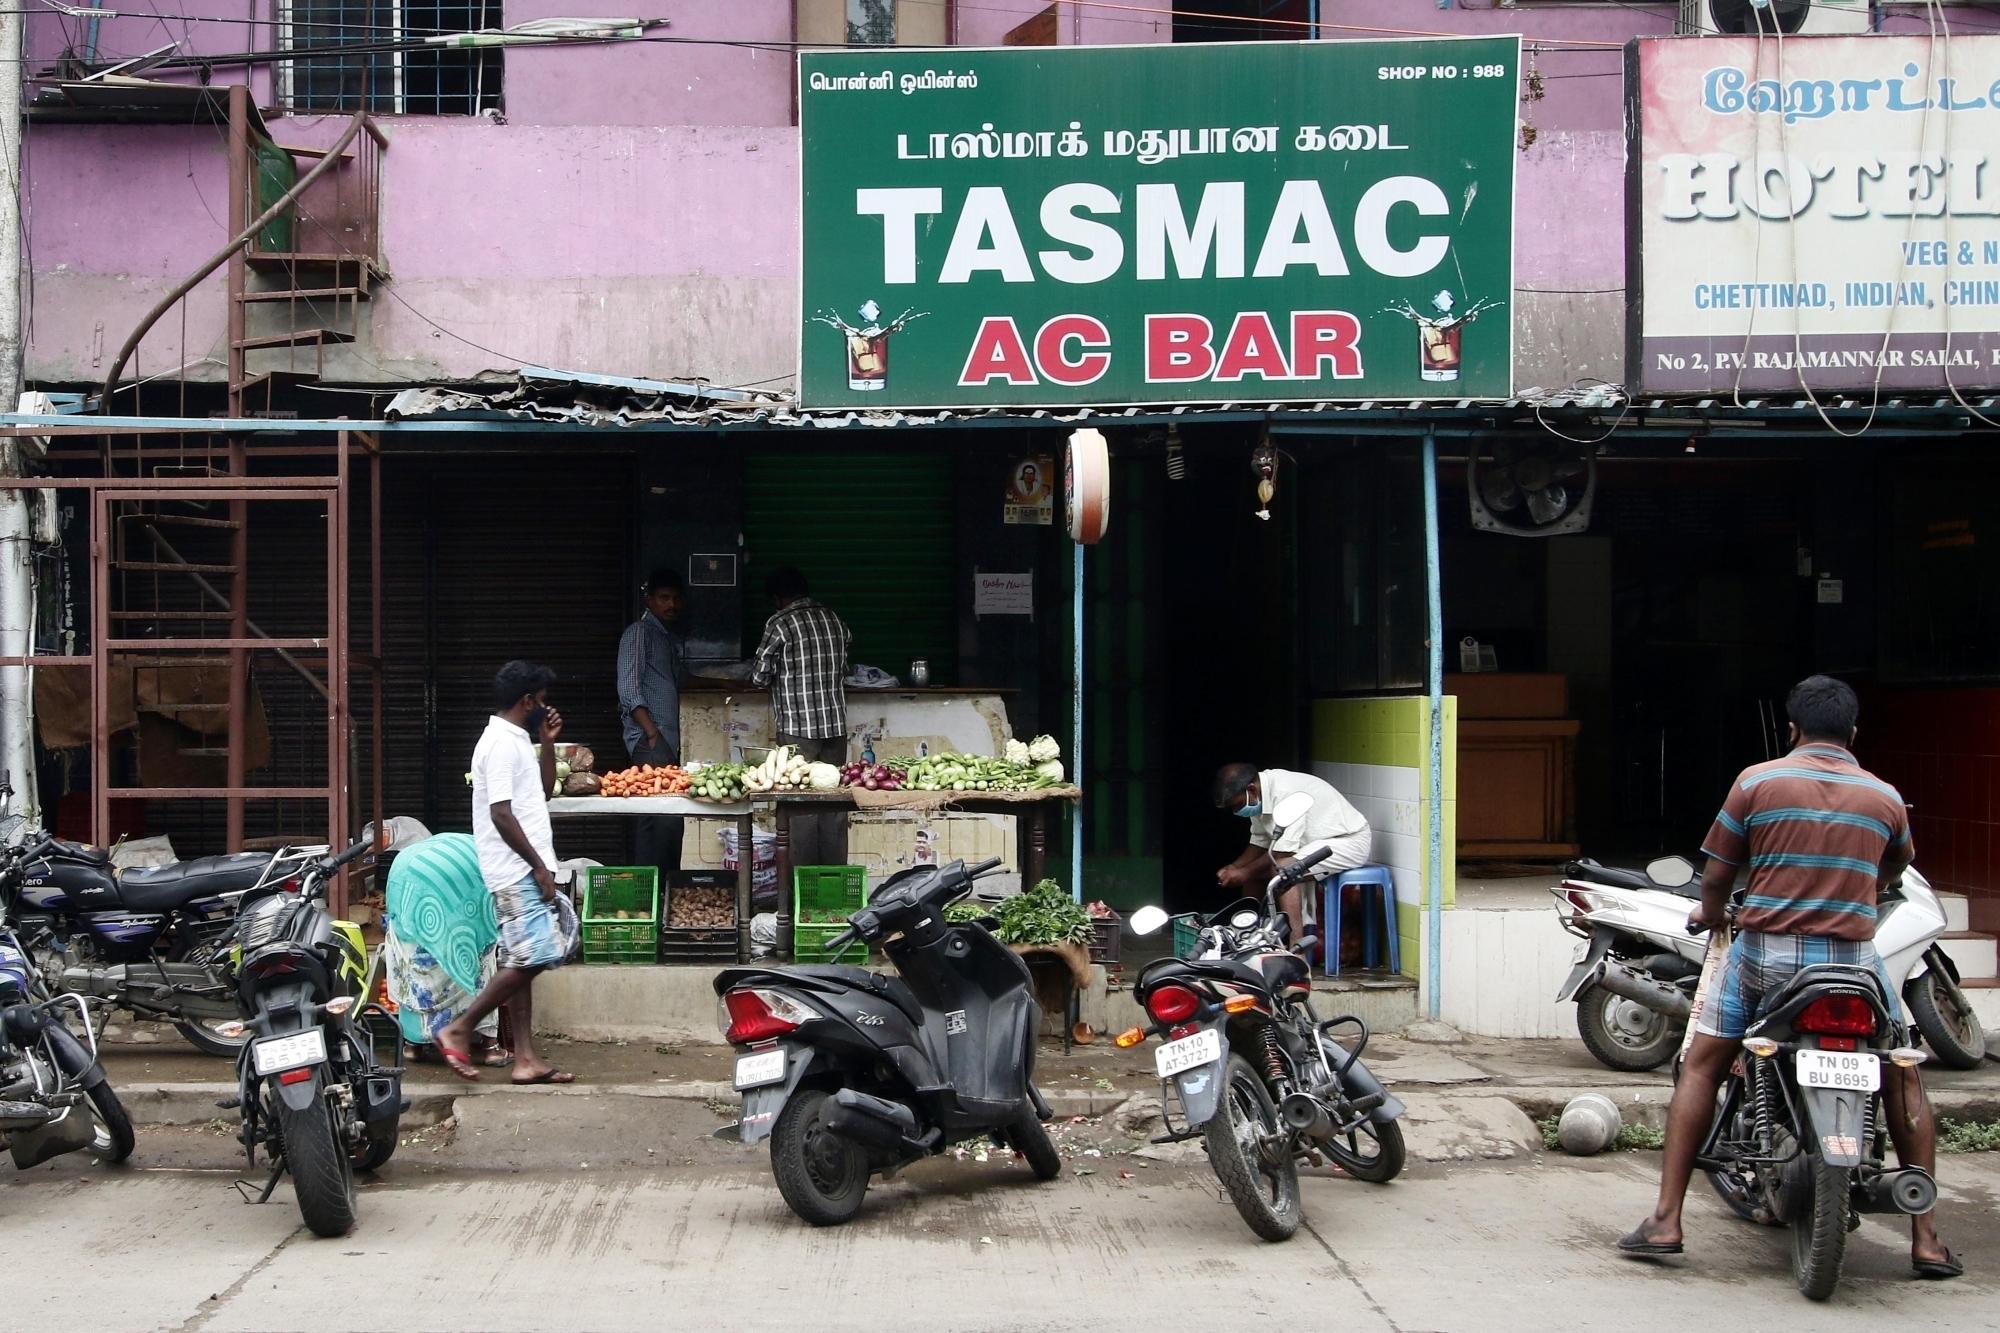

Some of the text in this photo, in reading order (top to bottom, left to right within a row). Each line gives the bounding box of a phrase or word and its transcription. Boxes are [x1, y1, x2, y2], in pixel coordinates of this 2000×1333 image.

[810, 70, 978, 95] பொன்னி ஒயின்ஸ்
[1377, 66, 1427, 80] SHOP
[1431, 66, 1458, 79] NO
[1473, 65, 1505, 78] 988
[896, 122, 1410, 165] டாஸ்மாக் மதுபான கடை
[1658, 152, 2000, 221] HOTEL
[856, 175, 1451, 284] TASMAC
[1901, 240, 1948, 266] VEG
[1957, 240, 1975, 266] &
[1694, 280, 2000, 312] CHETTINAD, INDIAN, CHIN
[956, 310, 1365, 387] AC BAR
[1657, 353, 1686, 370] No
[1691, 353, 1709, 374] 2,
[1752, 350, 1905, 371] RAJAMANNAR
[1910, 348, 1981, 371] SALAI,
[1169, 1036, 1204, 1056] TN-10
[1165, 1047, 1209, 1073] AT-3727
[1817, 1056, 1859, 1070] TN 09
[1809, 1072, 1869, 1088] BU 8695
